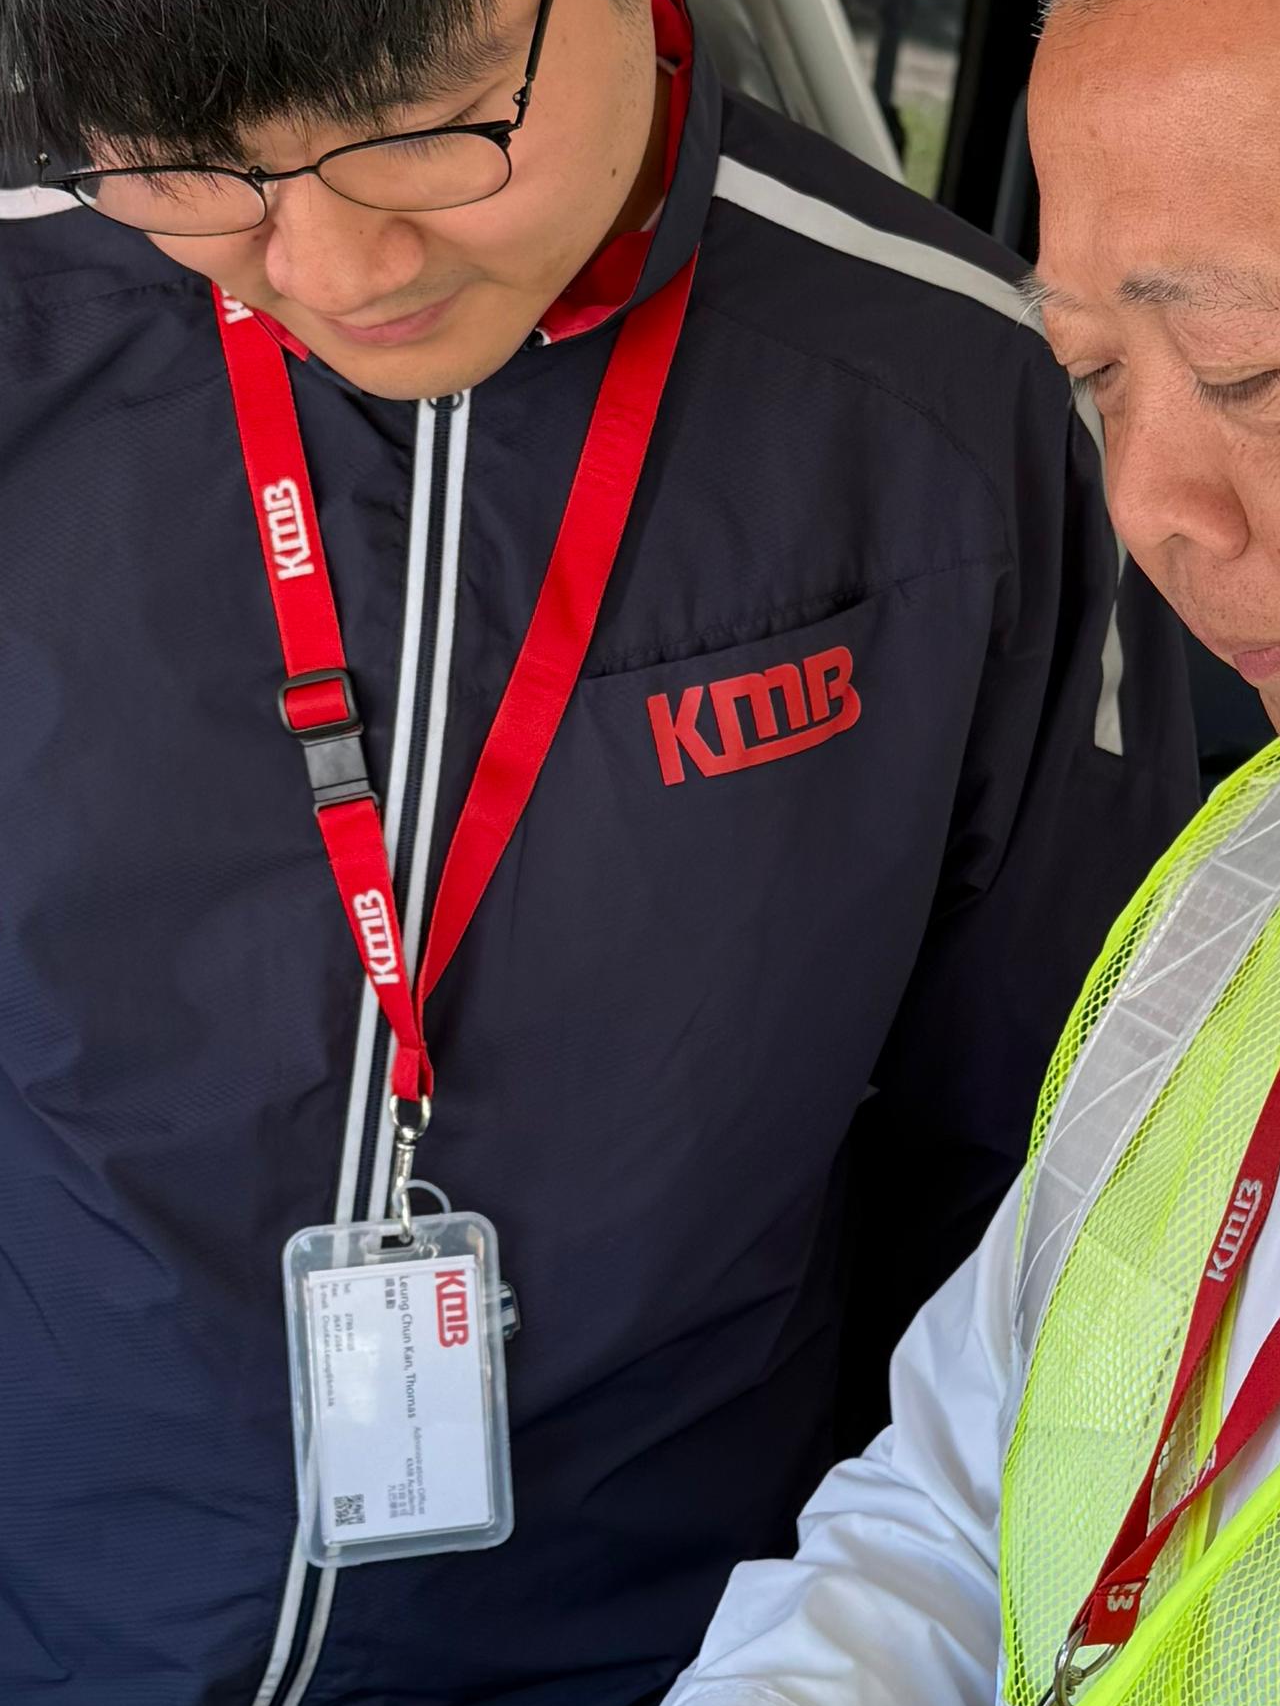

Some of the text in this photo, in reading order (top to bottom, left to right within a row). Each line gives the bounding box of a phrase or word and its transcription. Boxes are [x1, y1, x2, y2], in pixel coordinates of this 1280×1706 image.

[262, 476, 315, 581] KMB
[647, 645, 862, 787] KMB
[352, 888, 401, 985] KMB
[1206, 1178, 1263, 1282] KMB
[396, 1275, 420, 1418] Leung Chun Kan, Thomas
[435, 1269, 470, 1348] KMB
